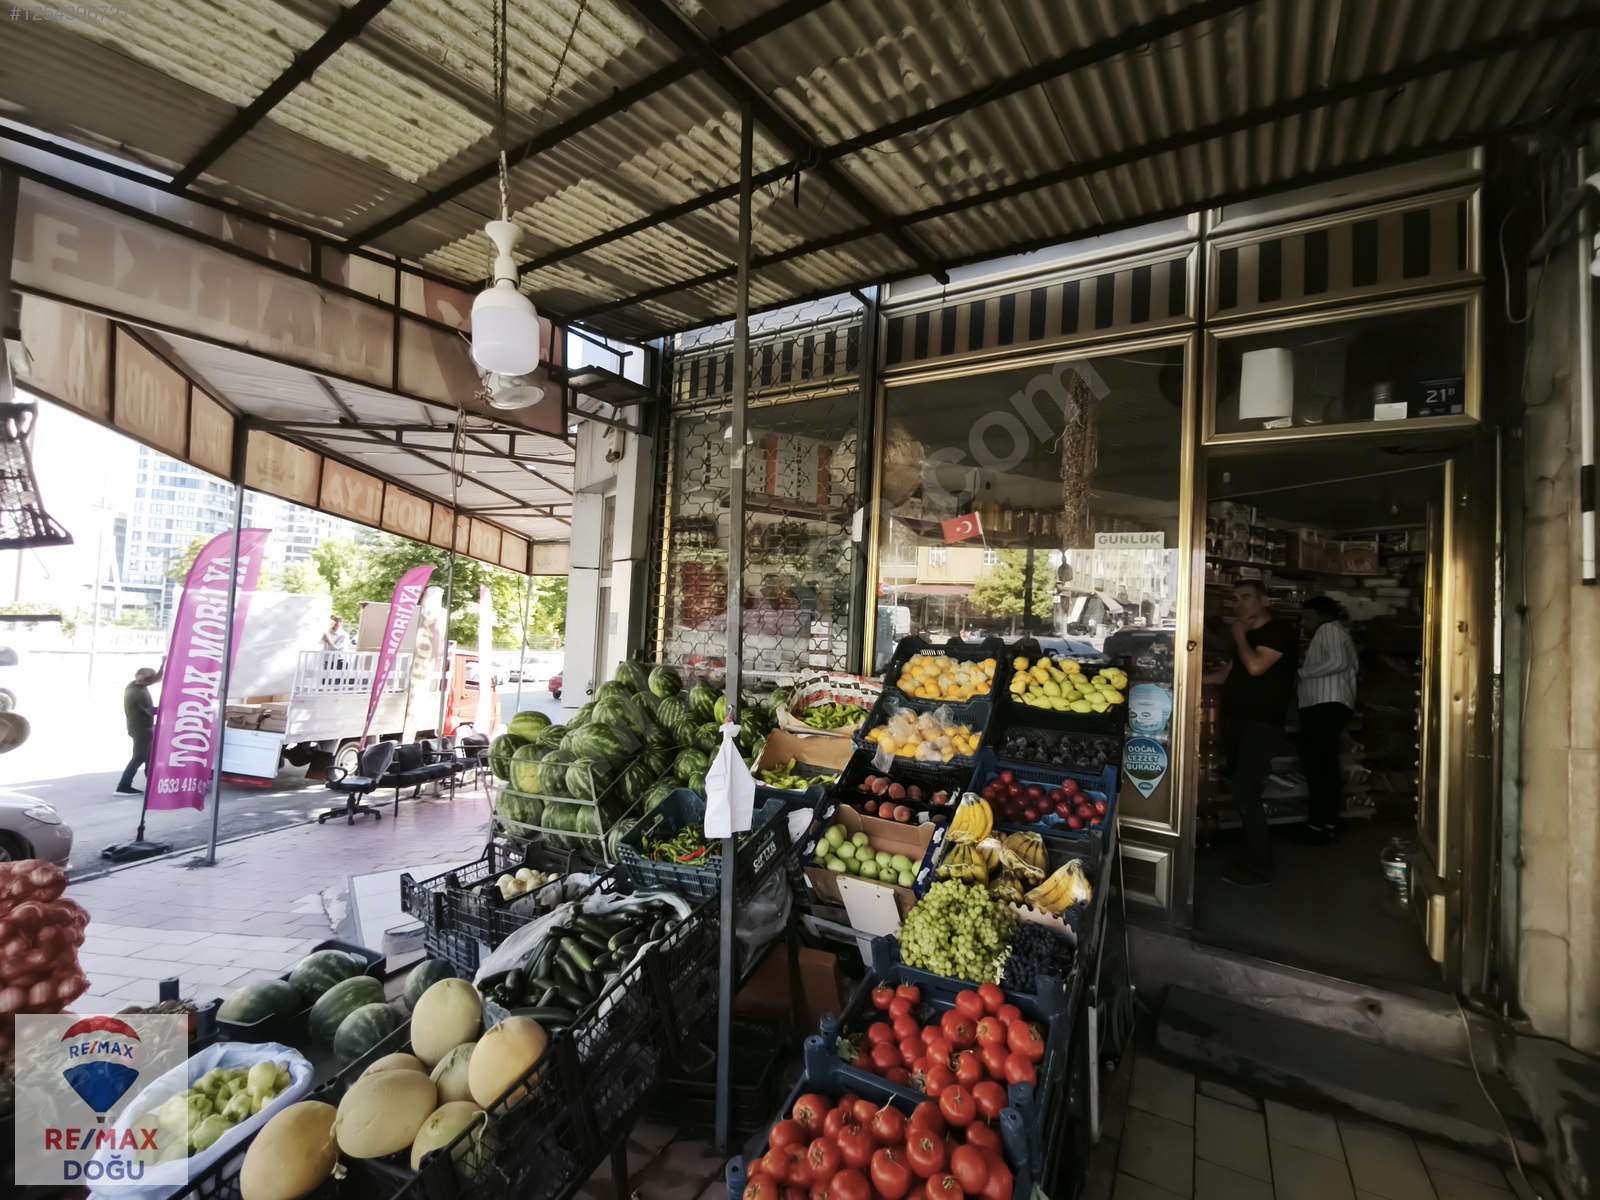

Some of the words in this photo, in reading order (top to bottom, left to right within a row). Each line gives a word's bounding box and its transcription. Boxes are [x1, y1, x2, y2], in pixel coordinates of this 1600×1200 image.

[168, 665, 223, 768] TOPRAK
[1127, 745, 1157, 753] DOĞAL
[1127, 755, 1159, 763] LEZZET
[1126, 763, 1162, 771] BURADA
[157, 778, 180, 794] 0532
